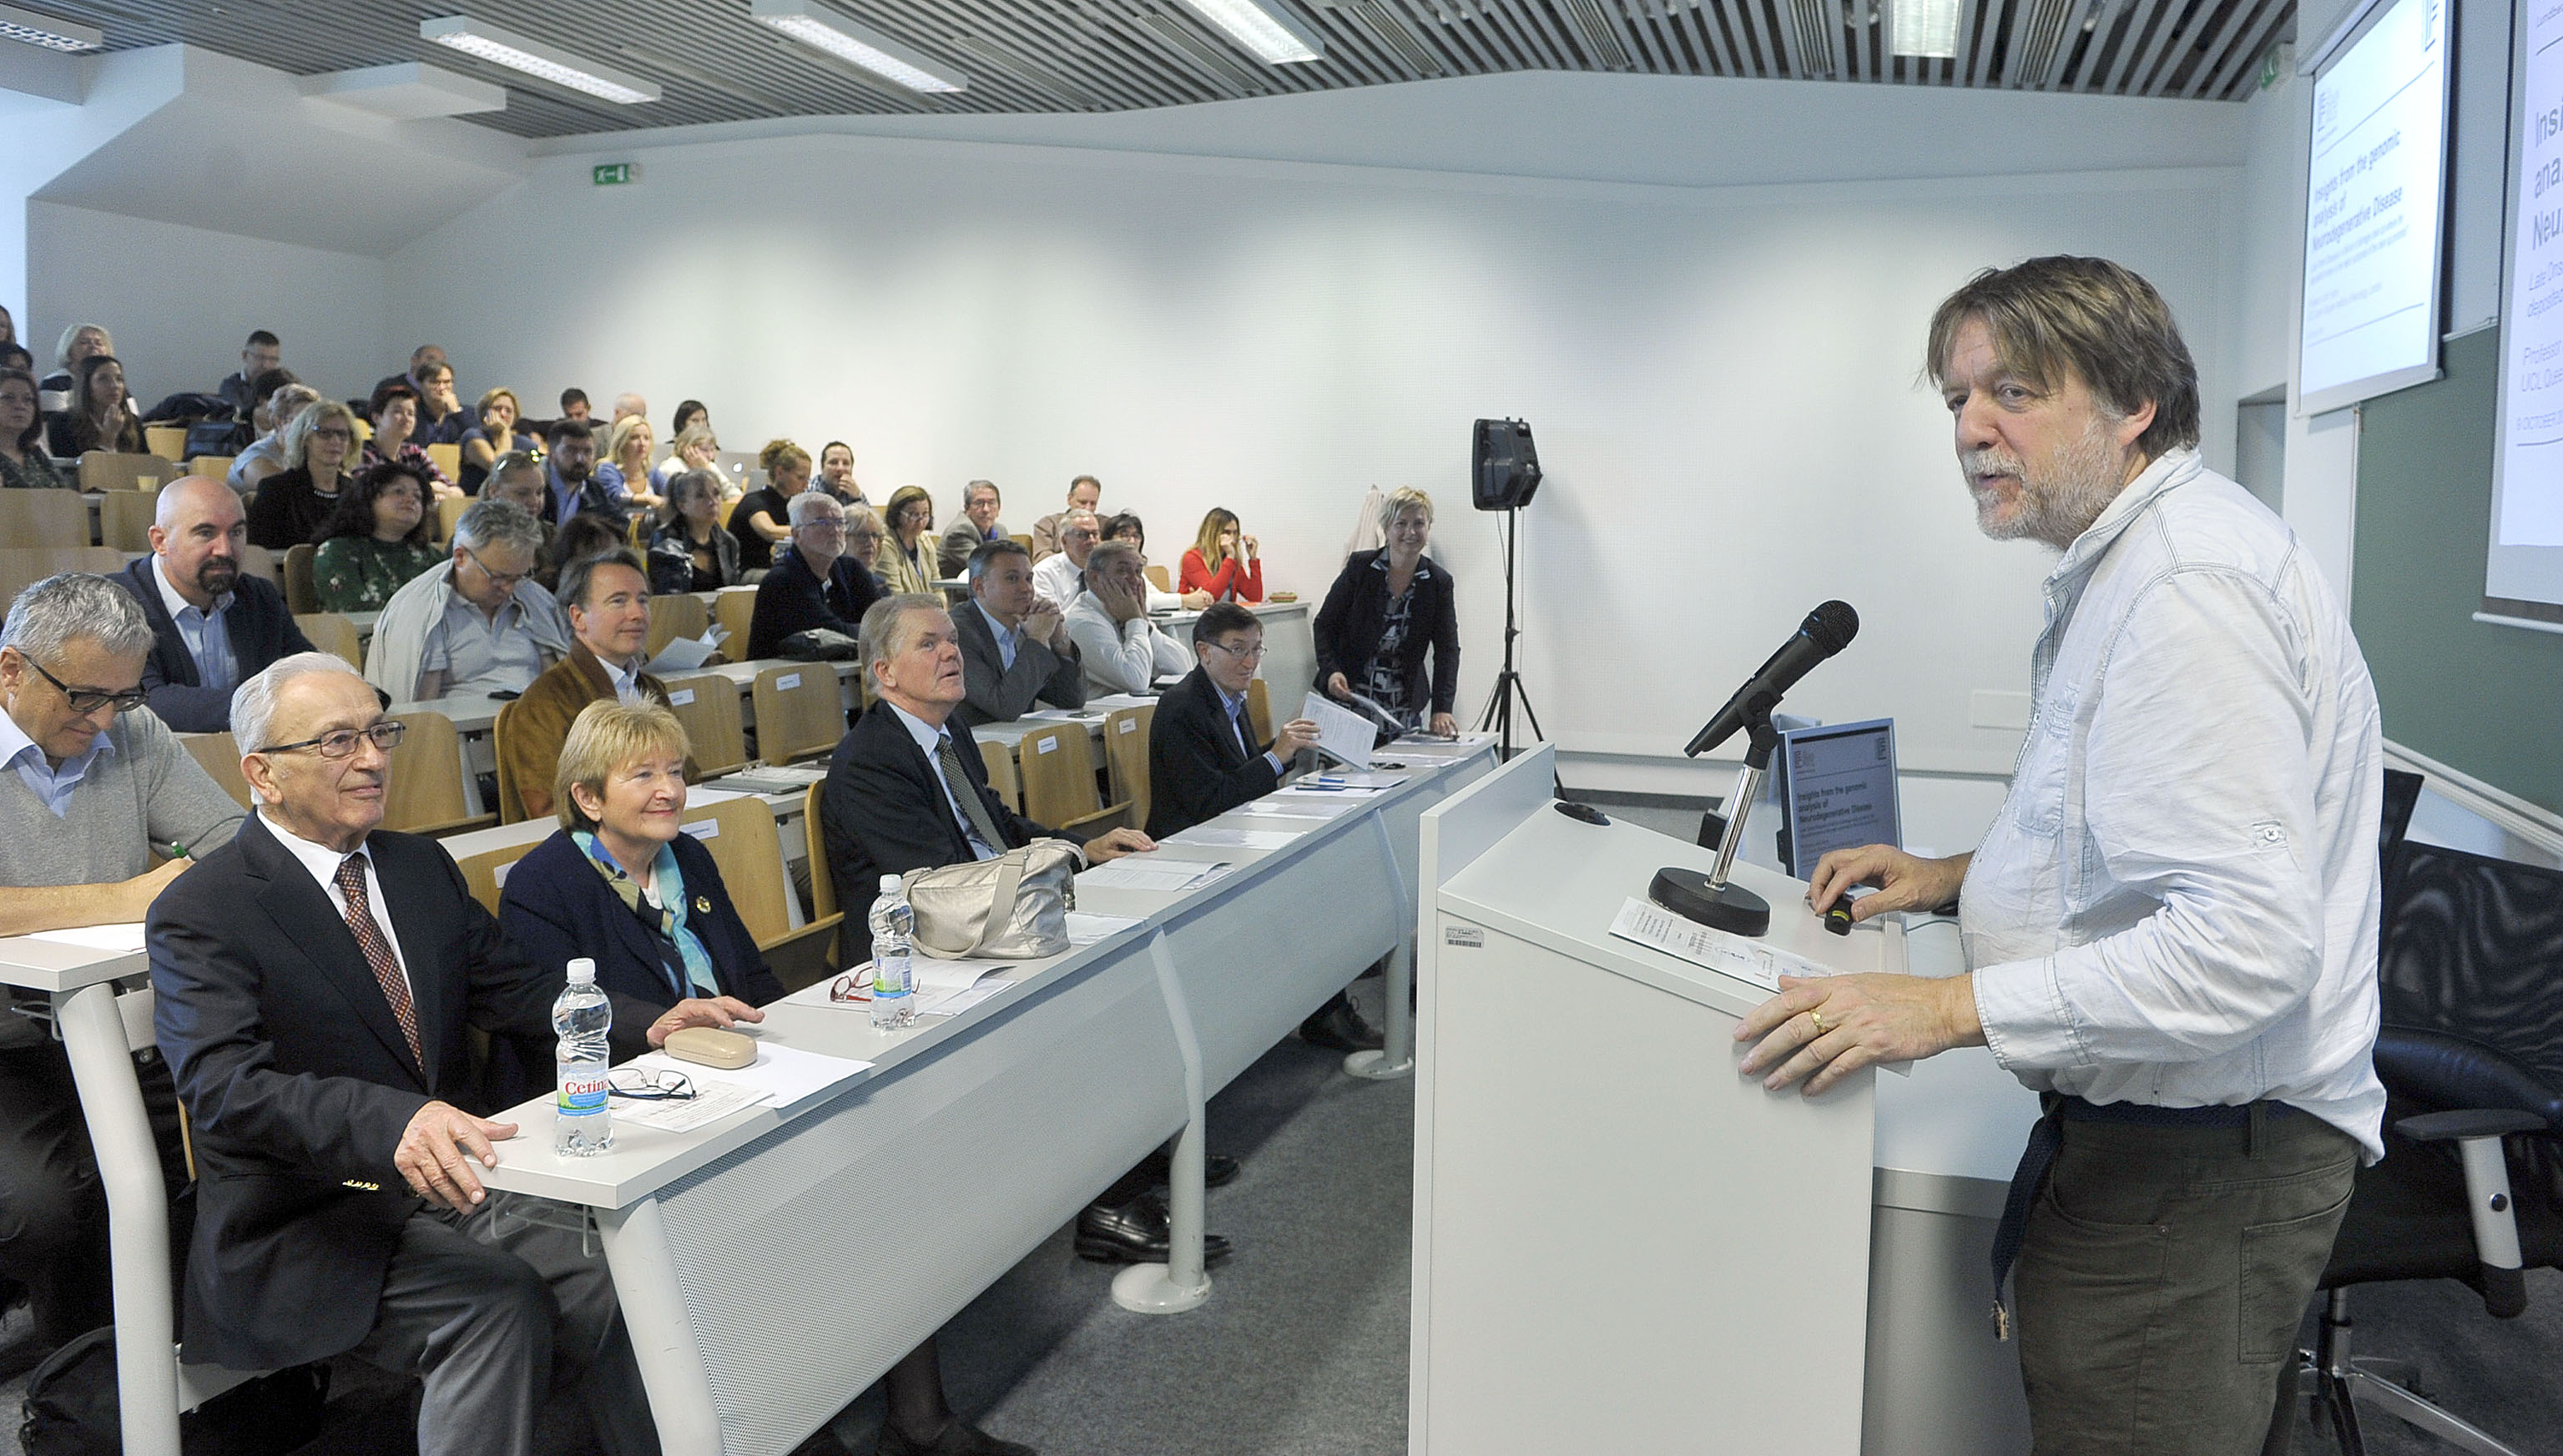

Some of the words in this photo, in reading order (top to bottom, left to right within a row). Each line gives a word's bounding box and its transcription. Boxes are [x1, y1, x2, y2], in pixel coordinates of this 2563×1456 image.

[2339, 165, 2355, 185] from
[2357, 154, 2368, 174] the
[2369, 128, 2401, 170] genomic
[2535, 157, 2563, 199] ana
[2373, 186, 2403, 217] Disease
[2532, 208, 2563, 250] Neu
